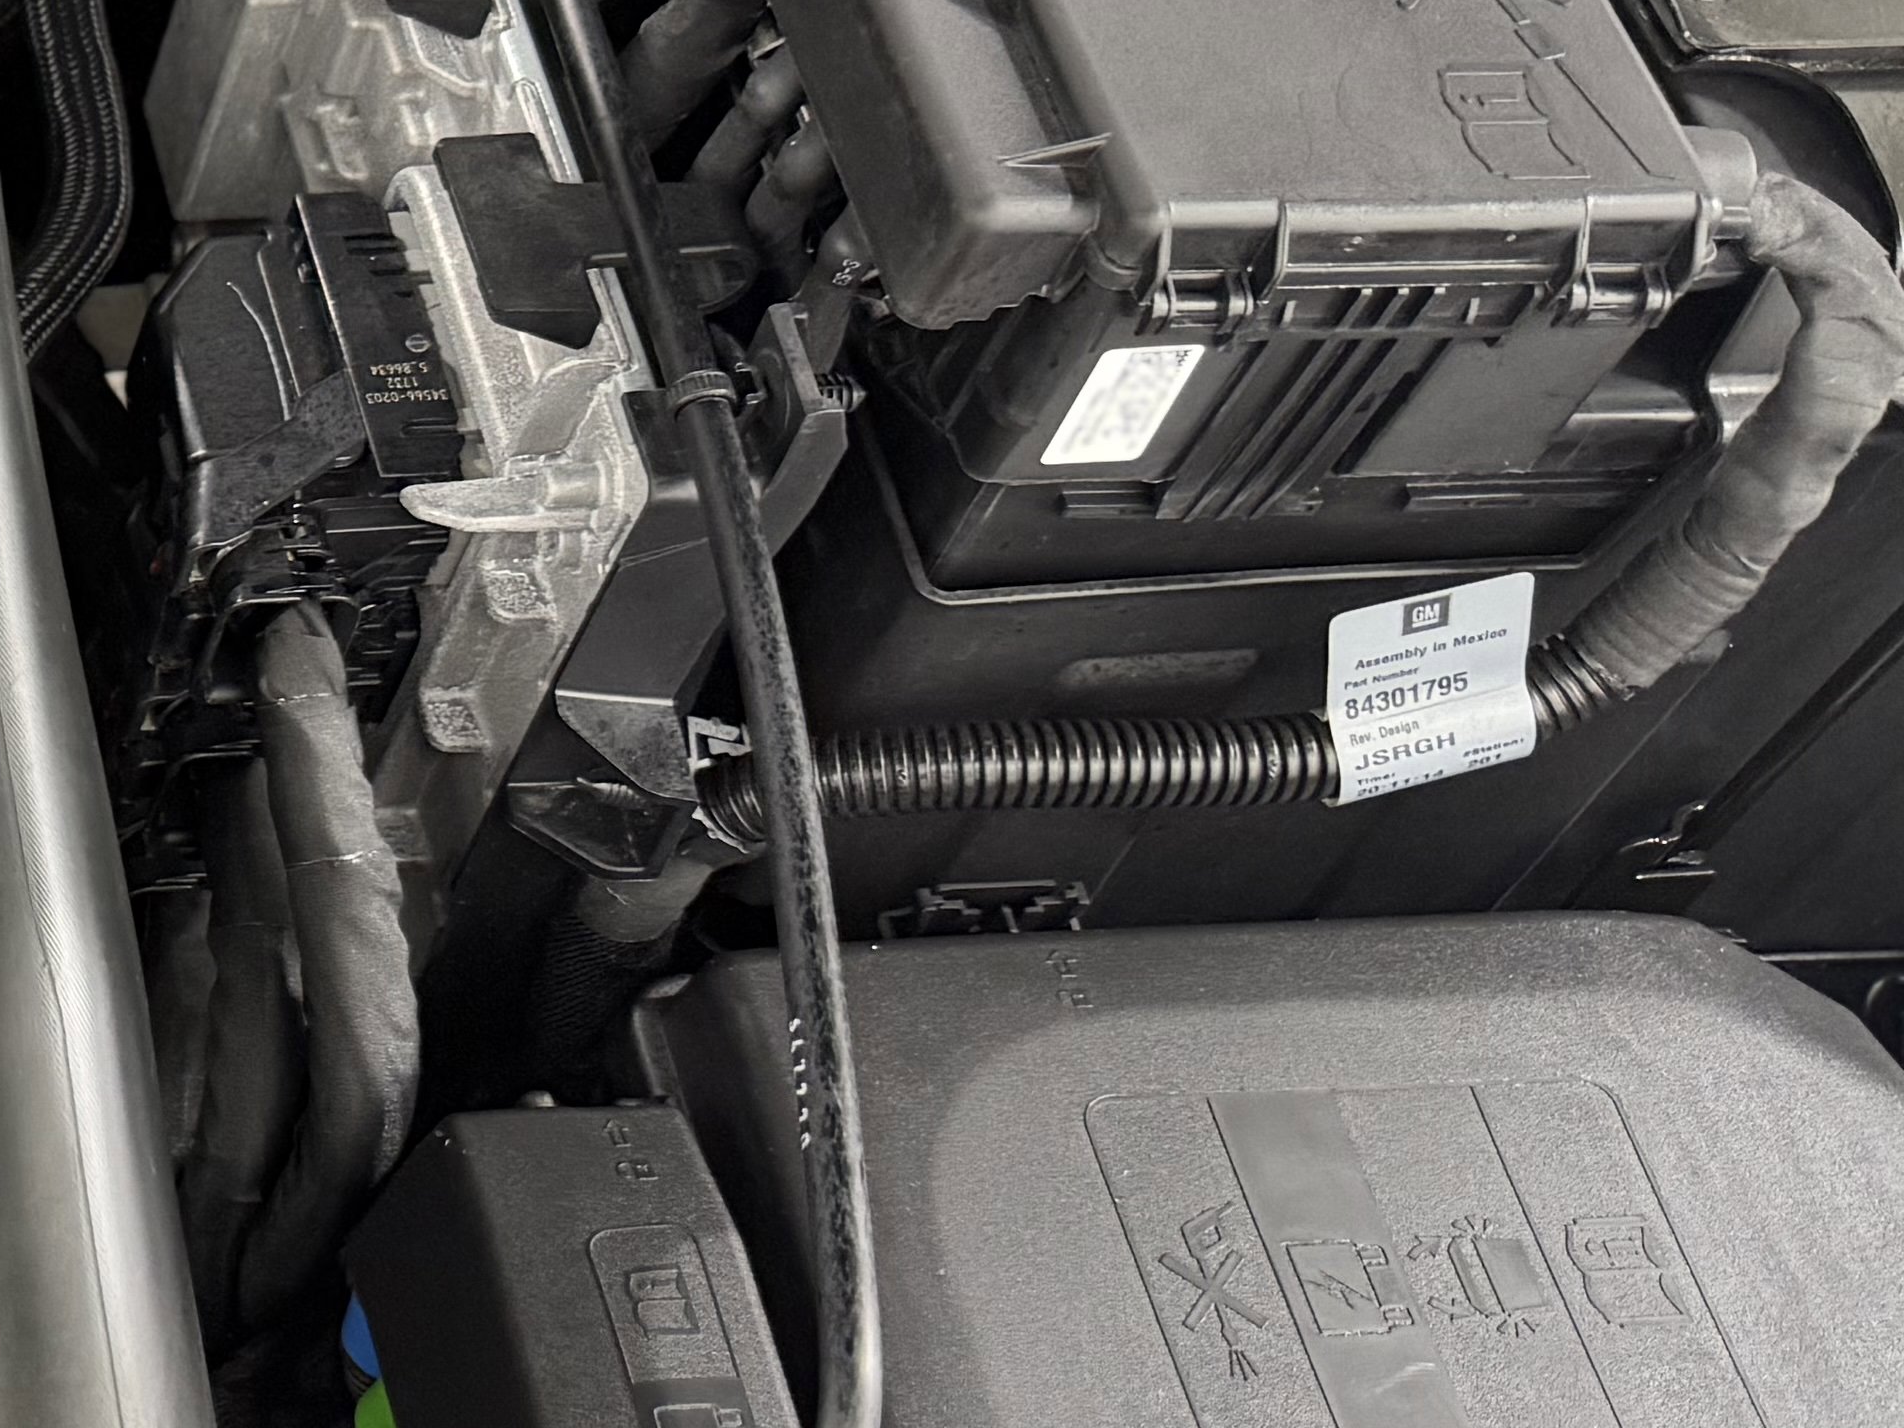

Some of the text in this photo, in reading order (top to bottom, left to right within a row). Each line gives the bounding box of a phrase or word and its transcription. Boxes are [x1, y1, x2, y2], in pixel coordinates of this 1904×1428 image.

[386, 376, 418, 389] 1732
[1412, 602, 1441, 624] GM
[1354, 627, 1508, 671] Assembly in Mexico
[1344, 665, 1420, 691] Part Number
[1345, 671, 1469, 719] 84301795
[1379, 719, 1421, 740] Design
[1355, 732, 1456, 771] JSRGH
